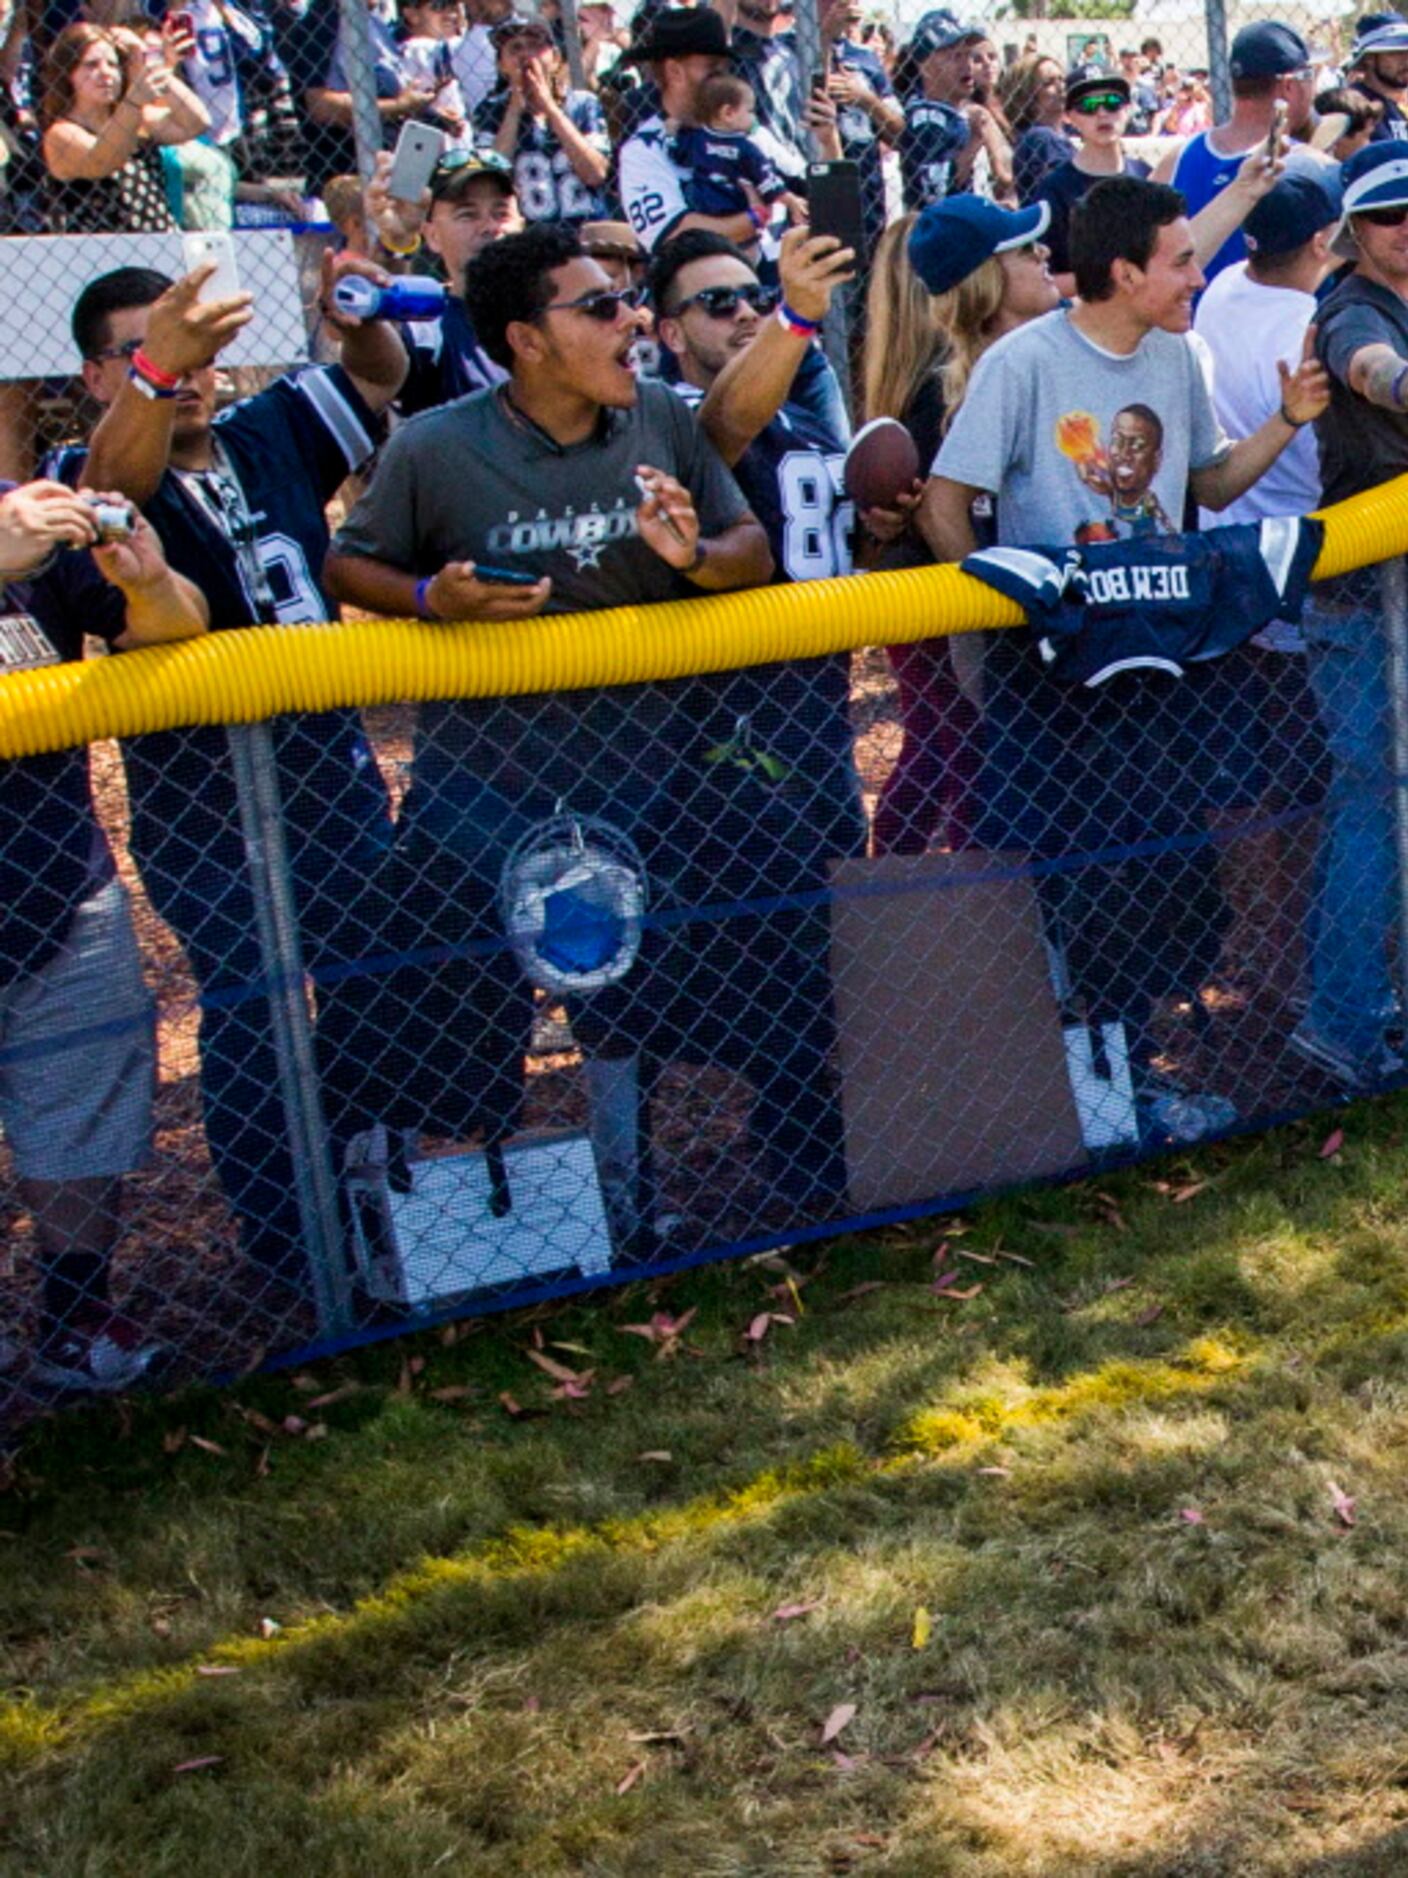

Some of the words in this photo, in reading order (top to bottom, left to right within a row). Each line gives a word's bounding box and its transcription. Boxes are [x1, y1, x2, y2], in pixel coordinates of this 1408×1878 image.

[198, 28, 233, 87] 9
[514, 150, 598, 222] 82
[628, 191, 666, 233] 82
[486, 507, 640, 556] COWBO
[507, 497, 626, 523] DALLA
